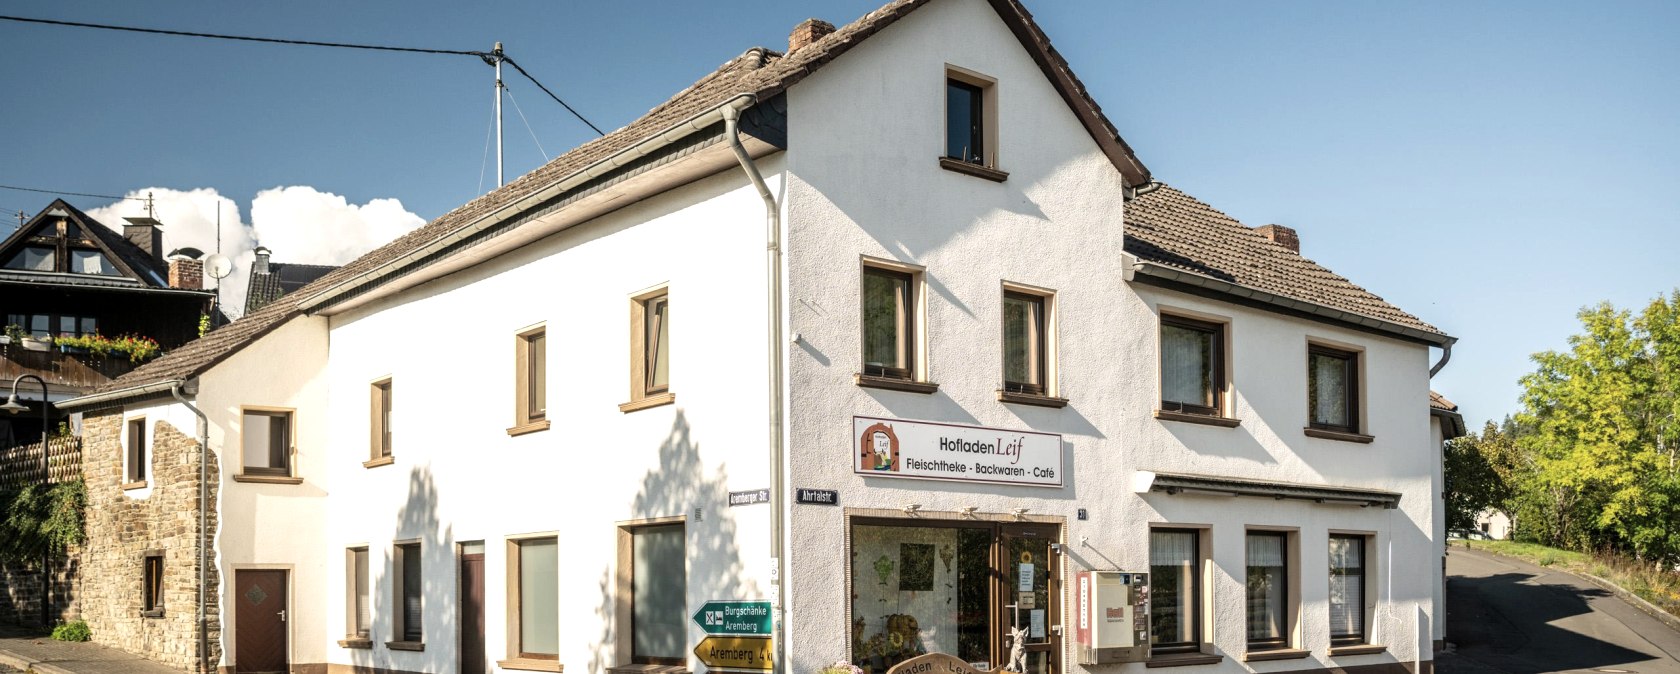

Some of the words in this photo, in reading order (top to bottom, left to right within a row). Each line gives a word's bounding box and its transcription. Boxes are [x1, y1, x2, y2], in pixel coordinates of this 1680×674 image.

[939, 436, 995, 455] Hofladen
[995, 436, 1025, 465] Leif
[906, 457, 967, 473] Fleischtheke
[975, 463, 1025, 477] Backwaren
[1033, 466, 1055, 479] Café
[730, 493, 758, 505] Aremberger
[759, 490, 768, 502] Str.
[802, 490, 832, 503] Ahrtalstr.
[725, 605, 767, 618] Burgschänke
[725, 621, 758, 632] Aremberg
[710, 646, 753, 664] Aremberg
[759, 647, 764, 661] 4
[949, 660, 972, 674] Lei
